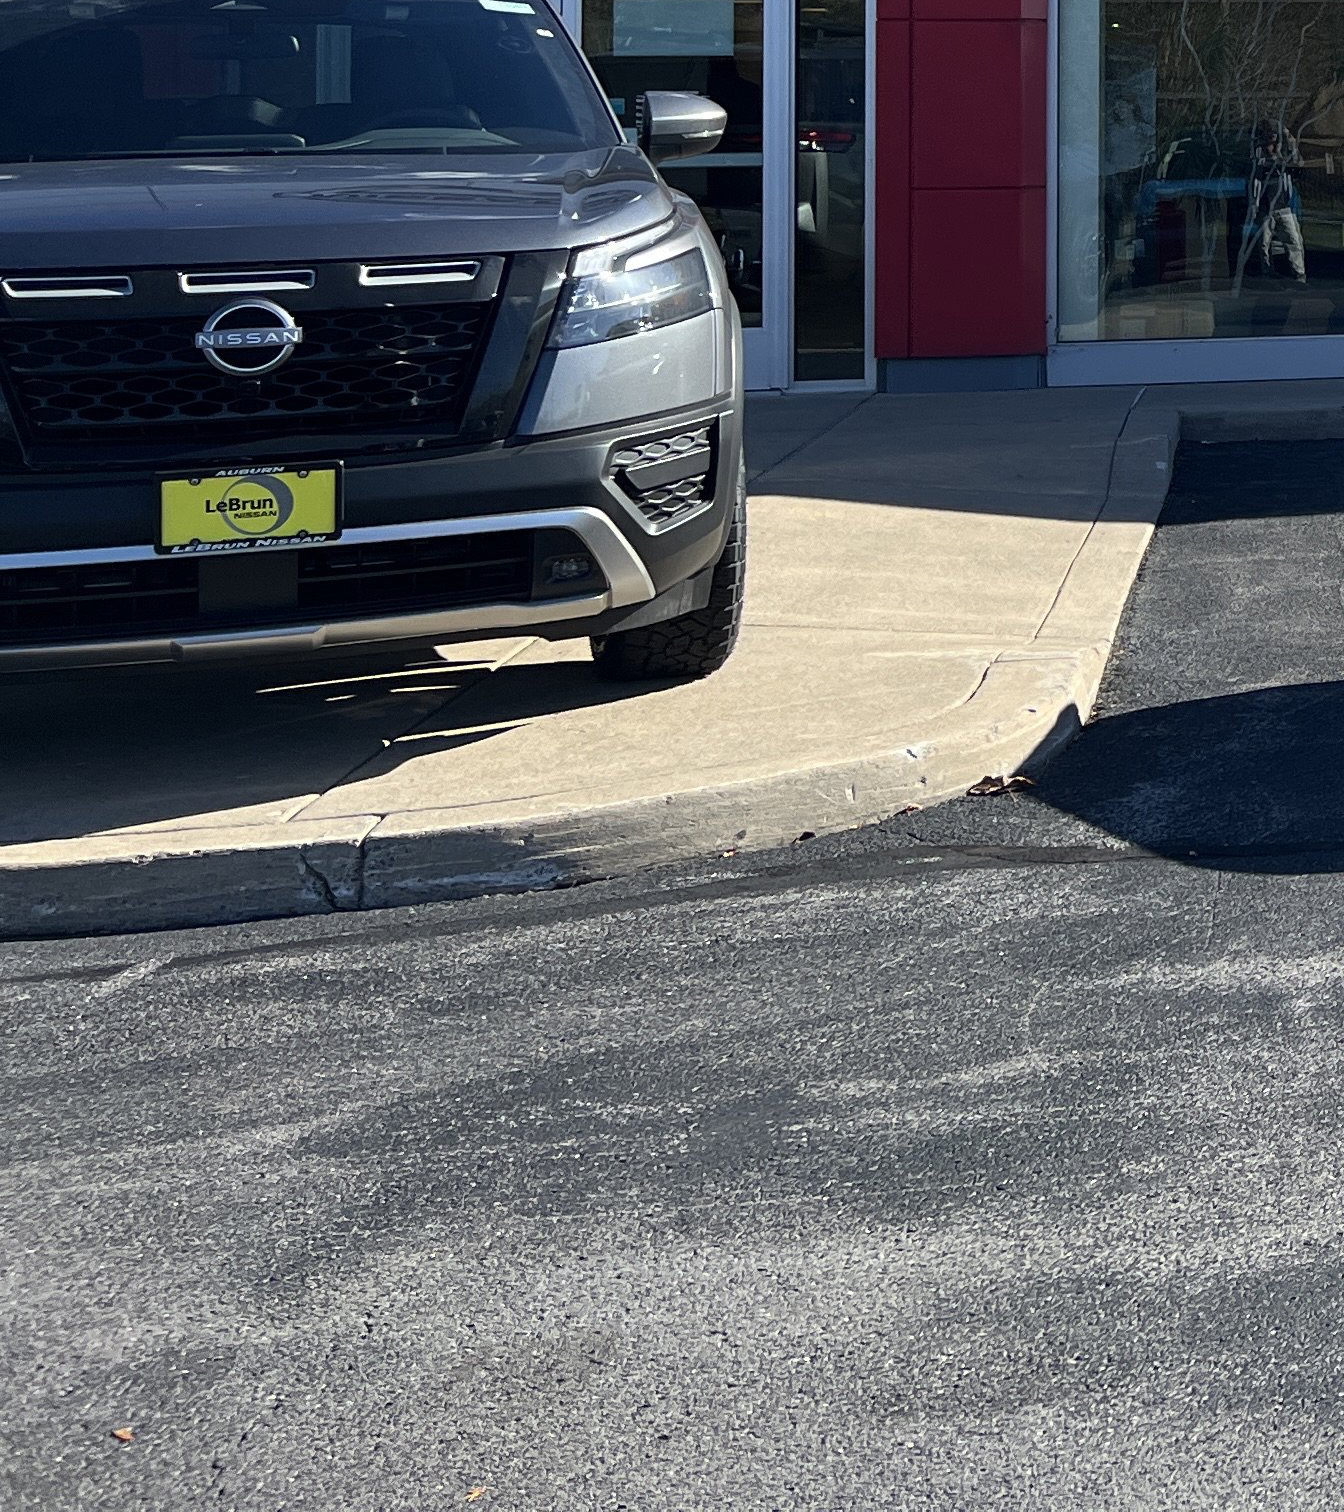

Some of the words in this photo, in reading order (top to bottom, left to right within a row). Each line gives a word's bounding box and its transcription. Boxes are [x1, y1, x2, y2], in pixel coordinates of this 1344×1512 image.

[198, 330, 299, 346] NISSAN
[215, 466, 285, 477] AUBURN
[205, 497, 273, 513] LeBrun
[233, 510, 278, 519] NISSAN
[255, 535, 327, 547] NISSAN
